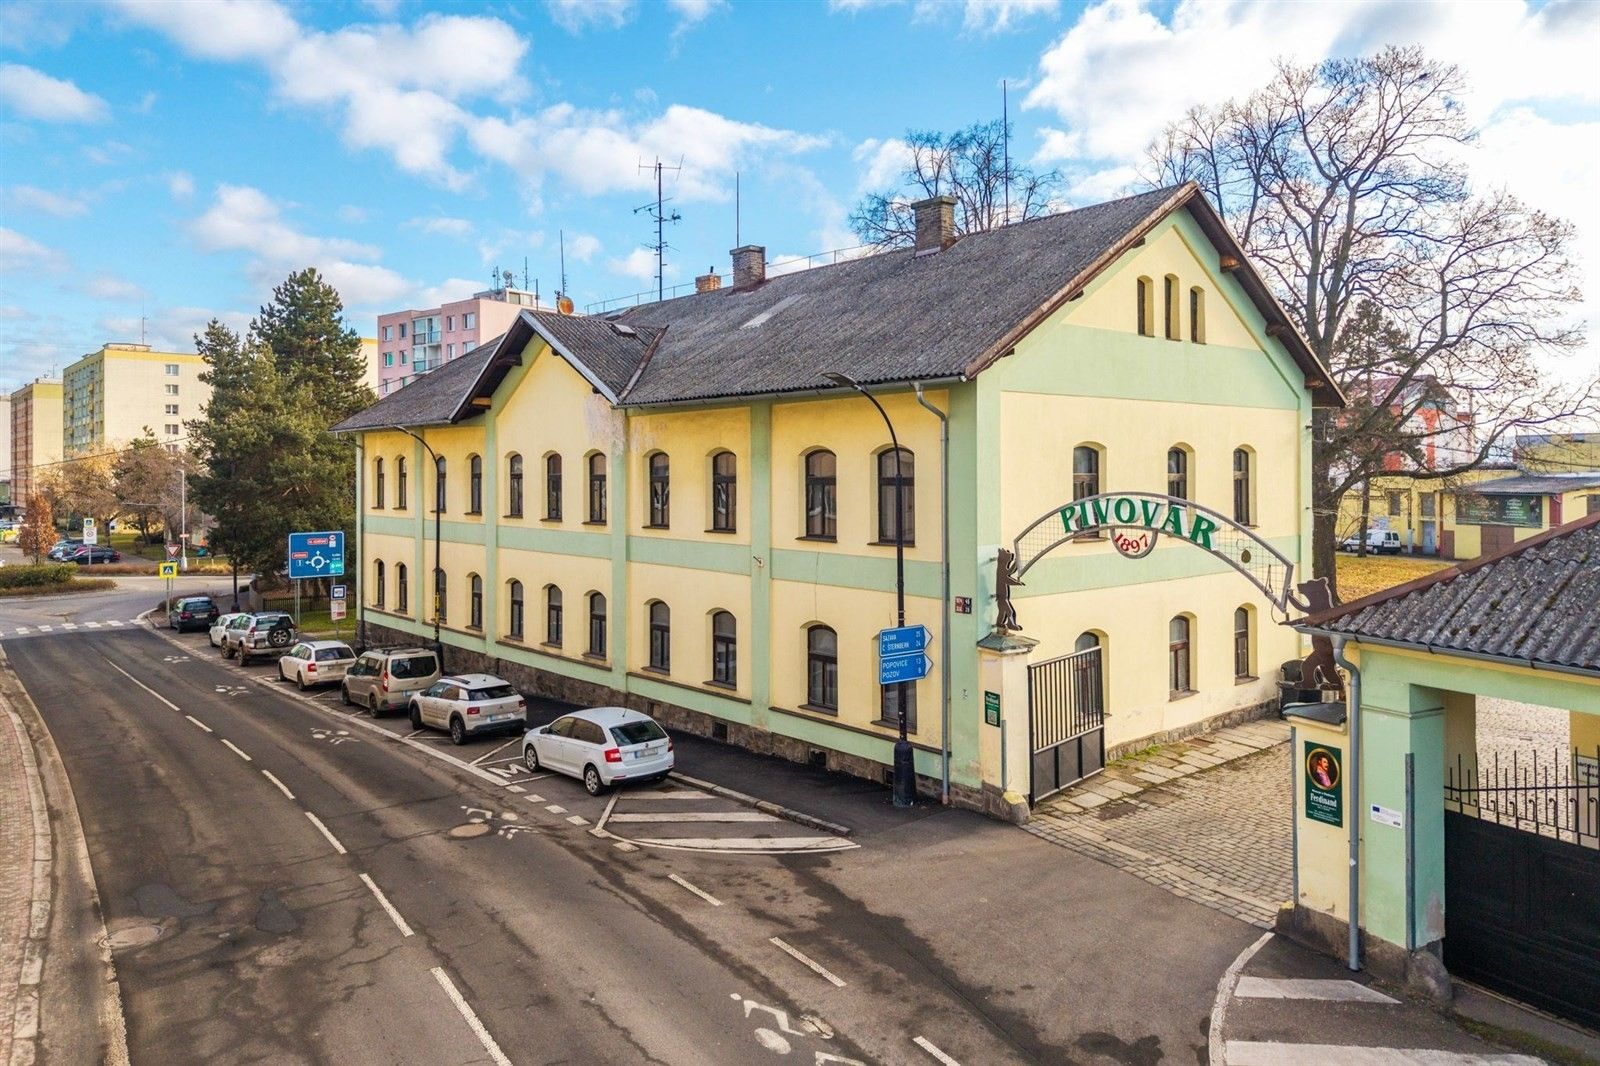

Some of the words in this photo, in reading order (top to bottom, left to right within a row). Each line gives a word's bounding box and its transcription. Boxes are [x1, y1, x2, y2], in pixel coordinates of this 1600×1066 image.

[1060, 497, 1221, 551] PIVOVAR
[1114, 532, 1150, 554] 1897
[882, 660, 907, 669] POPOVICE
[1310, 792, 1337, 808] Ferdinand
